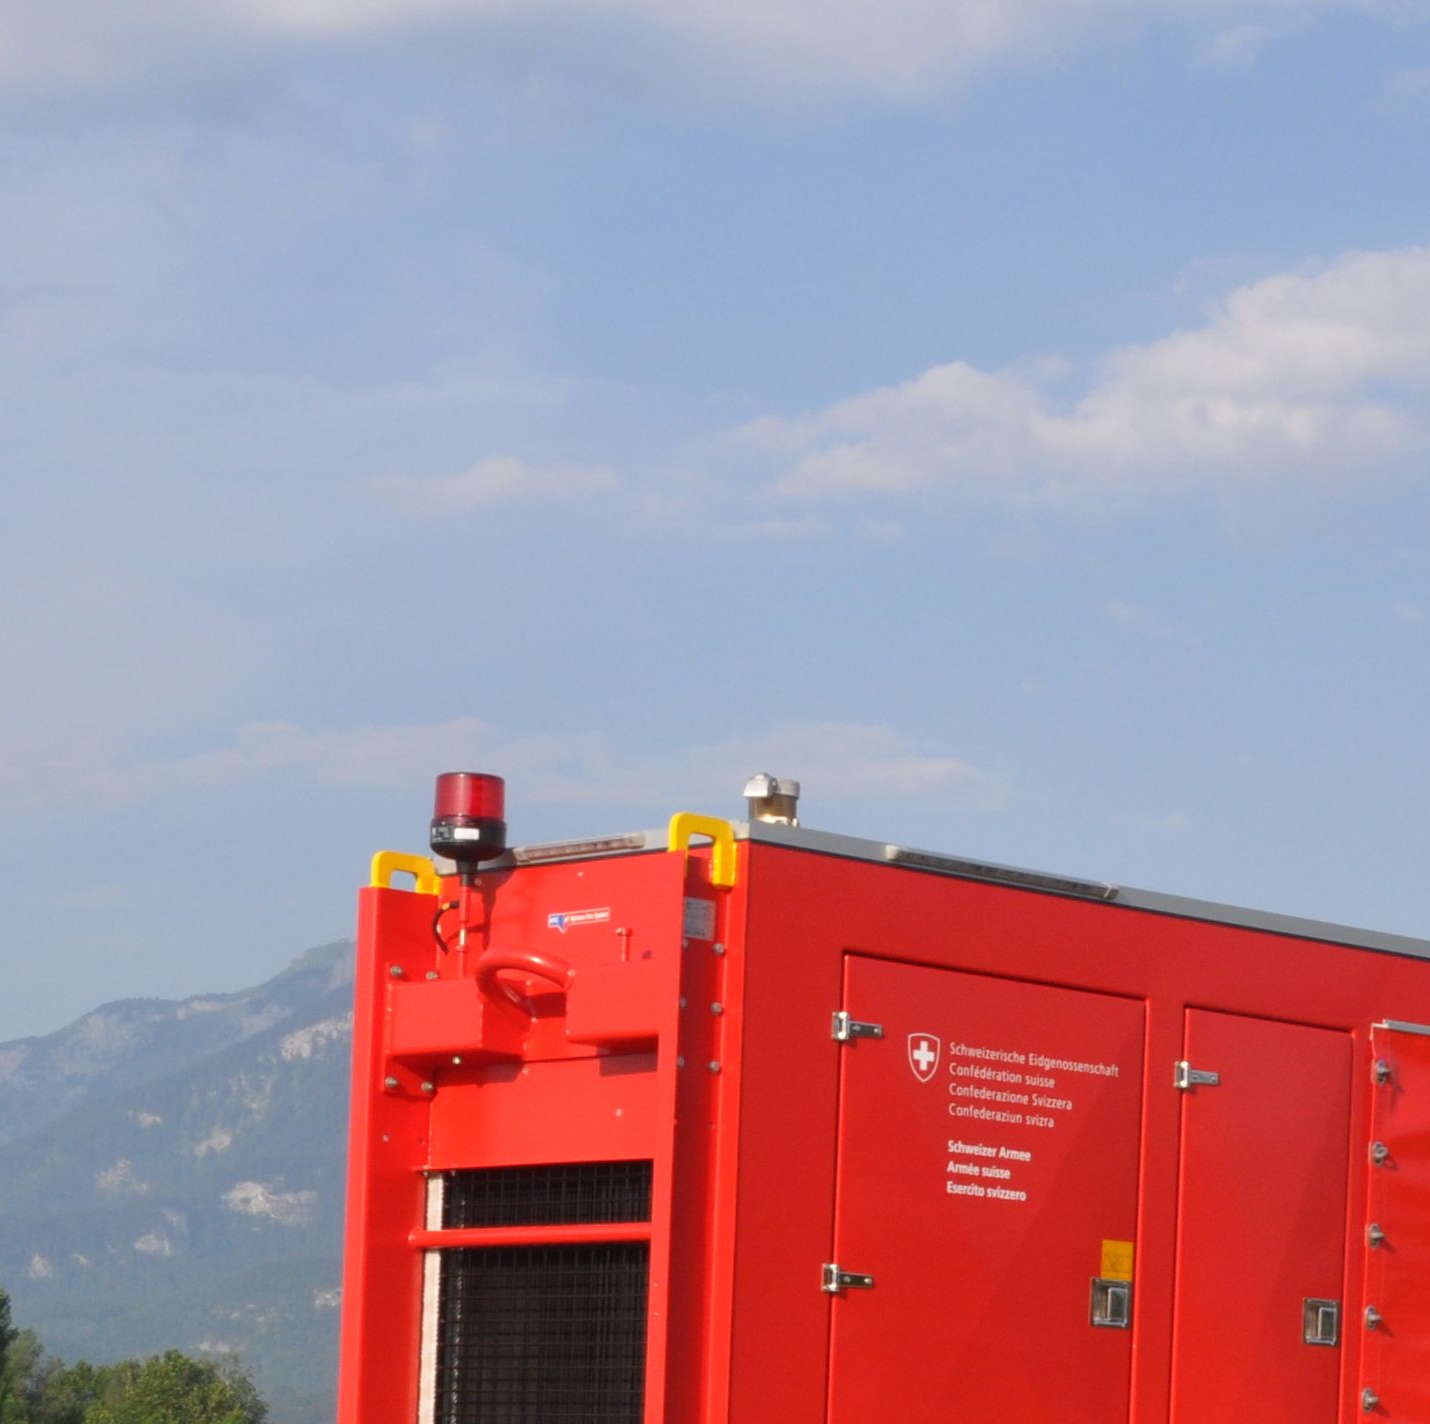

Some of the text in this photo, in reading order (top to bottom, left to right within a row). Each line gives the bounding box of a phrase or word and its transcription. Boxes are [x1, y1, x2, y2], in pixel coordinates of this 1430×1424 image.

[949, 1042, 1119, 1078] Schweizerische Eidgenossenschaft
[948, 1062, 1056, 1088] Confédération suisse
[948, 1082, 1073, 1110] Confederazione Svizzera
[948, 1102, 1055, 1128] Confederaziun svizra
[947, 1140, 1032, 1161] Schweizer Armee
[946, 1161, 1011, 1179] Armée suisse
[946, 1180, 1027, 1201] Esercito svizzero
